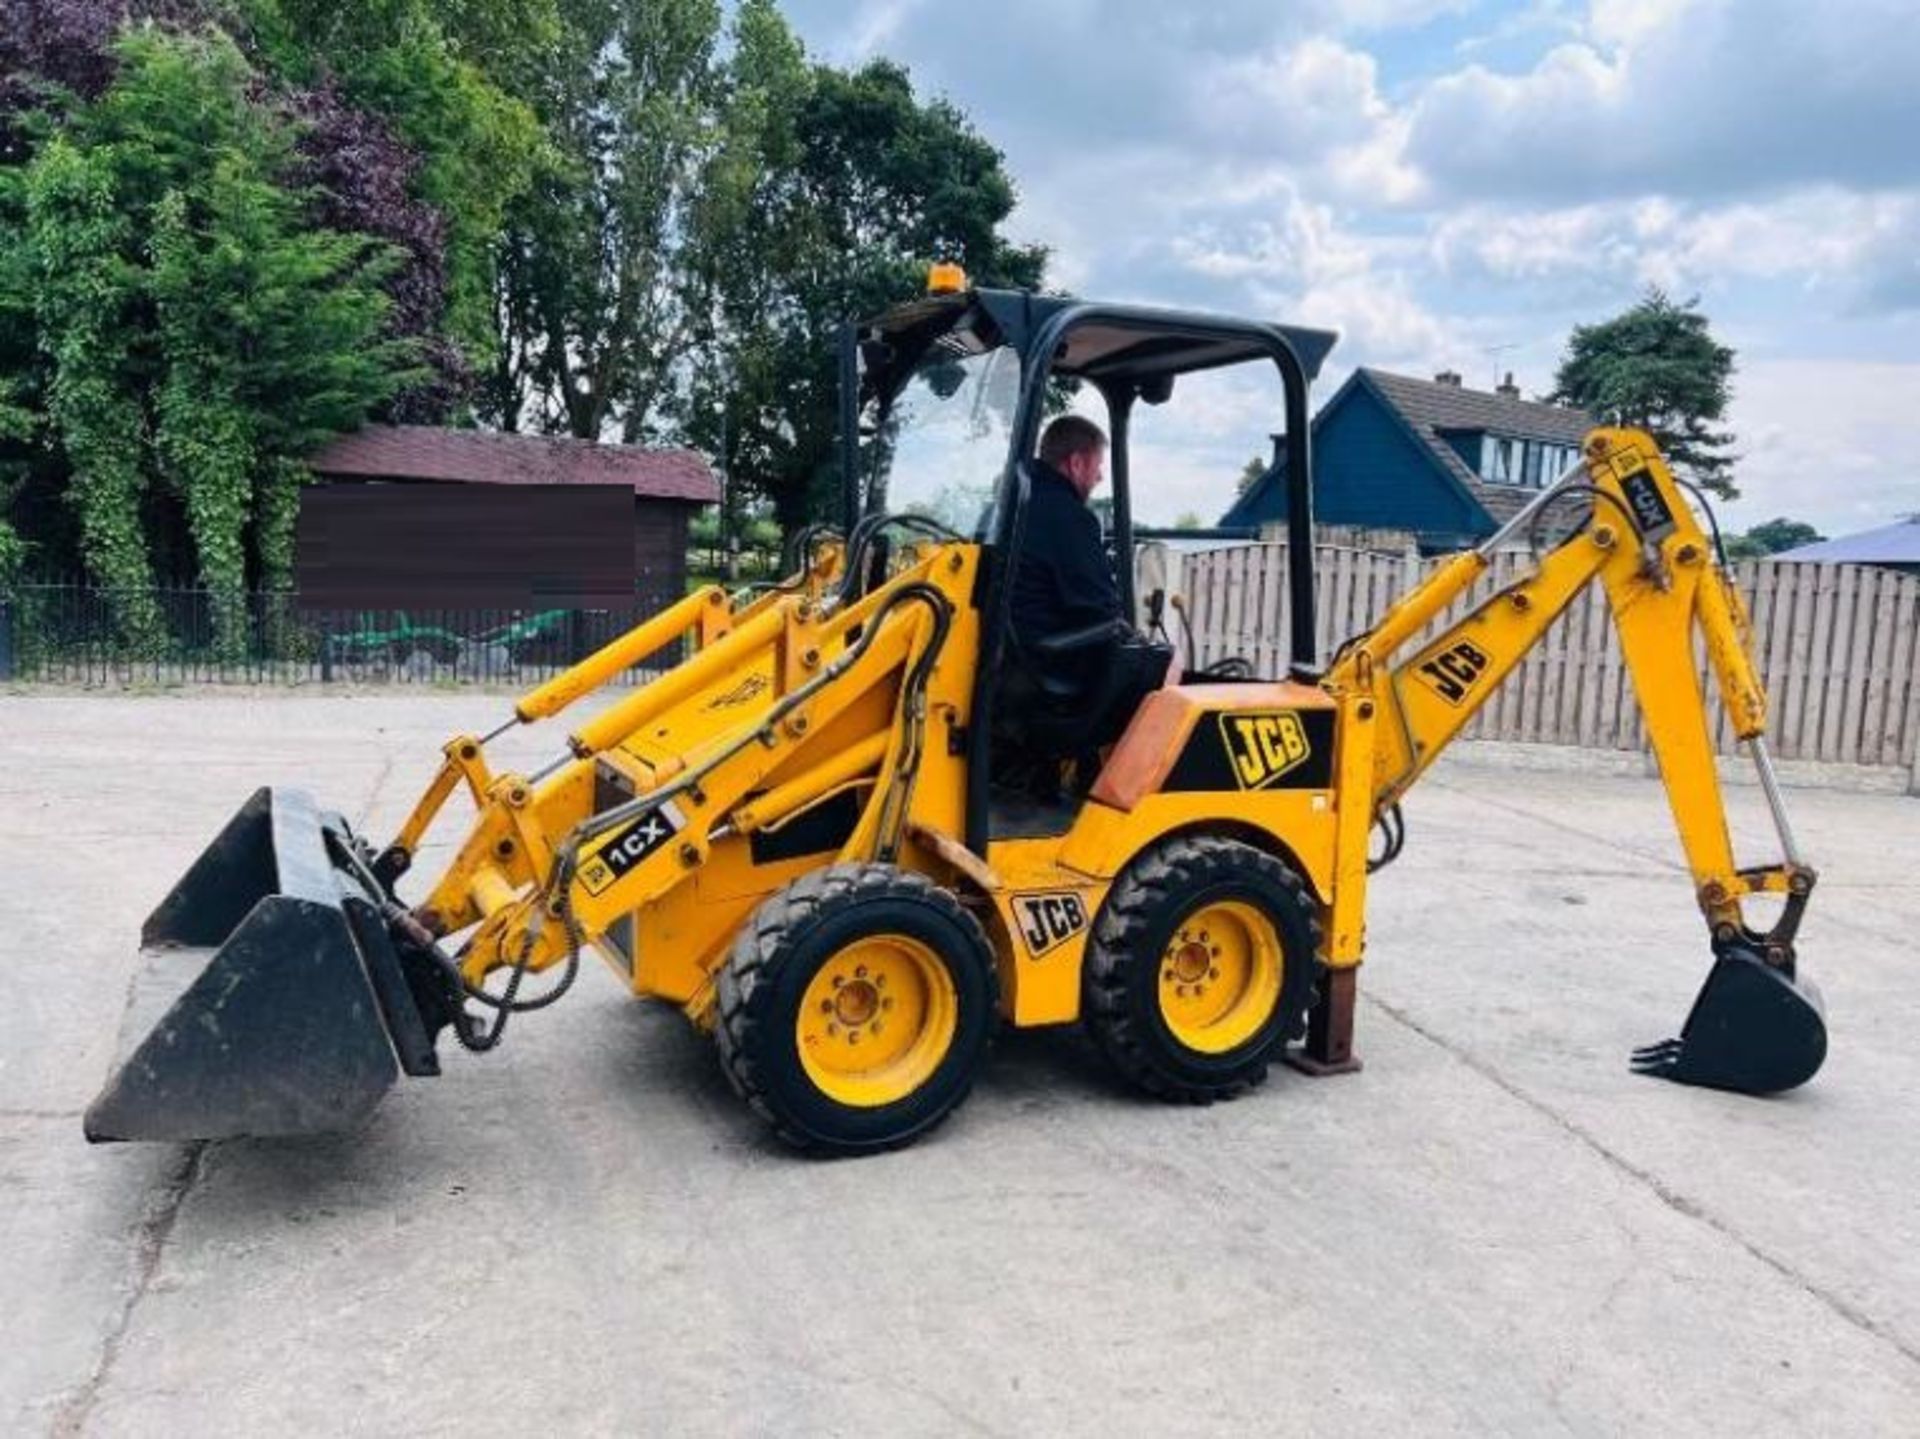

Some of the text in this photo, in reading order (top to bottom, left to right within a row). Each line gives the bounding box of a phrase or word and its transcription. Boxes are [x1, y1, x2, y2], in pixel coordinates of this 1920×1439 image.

[1421, 642, 1487, 702] JCB
[1235, 718, 1303, 784] JCB
[609, 817, 666, 865] 1CX
[1025, 897, 1082, 952] JCB
